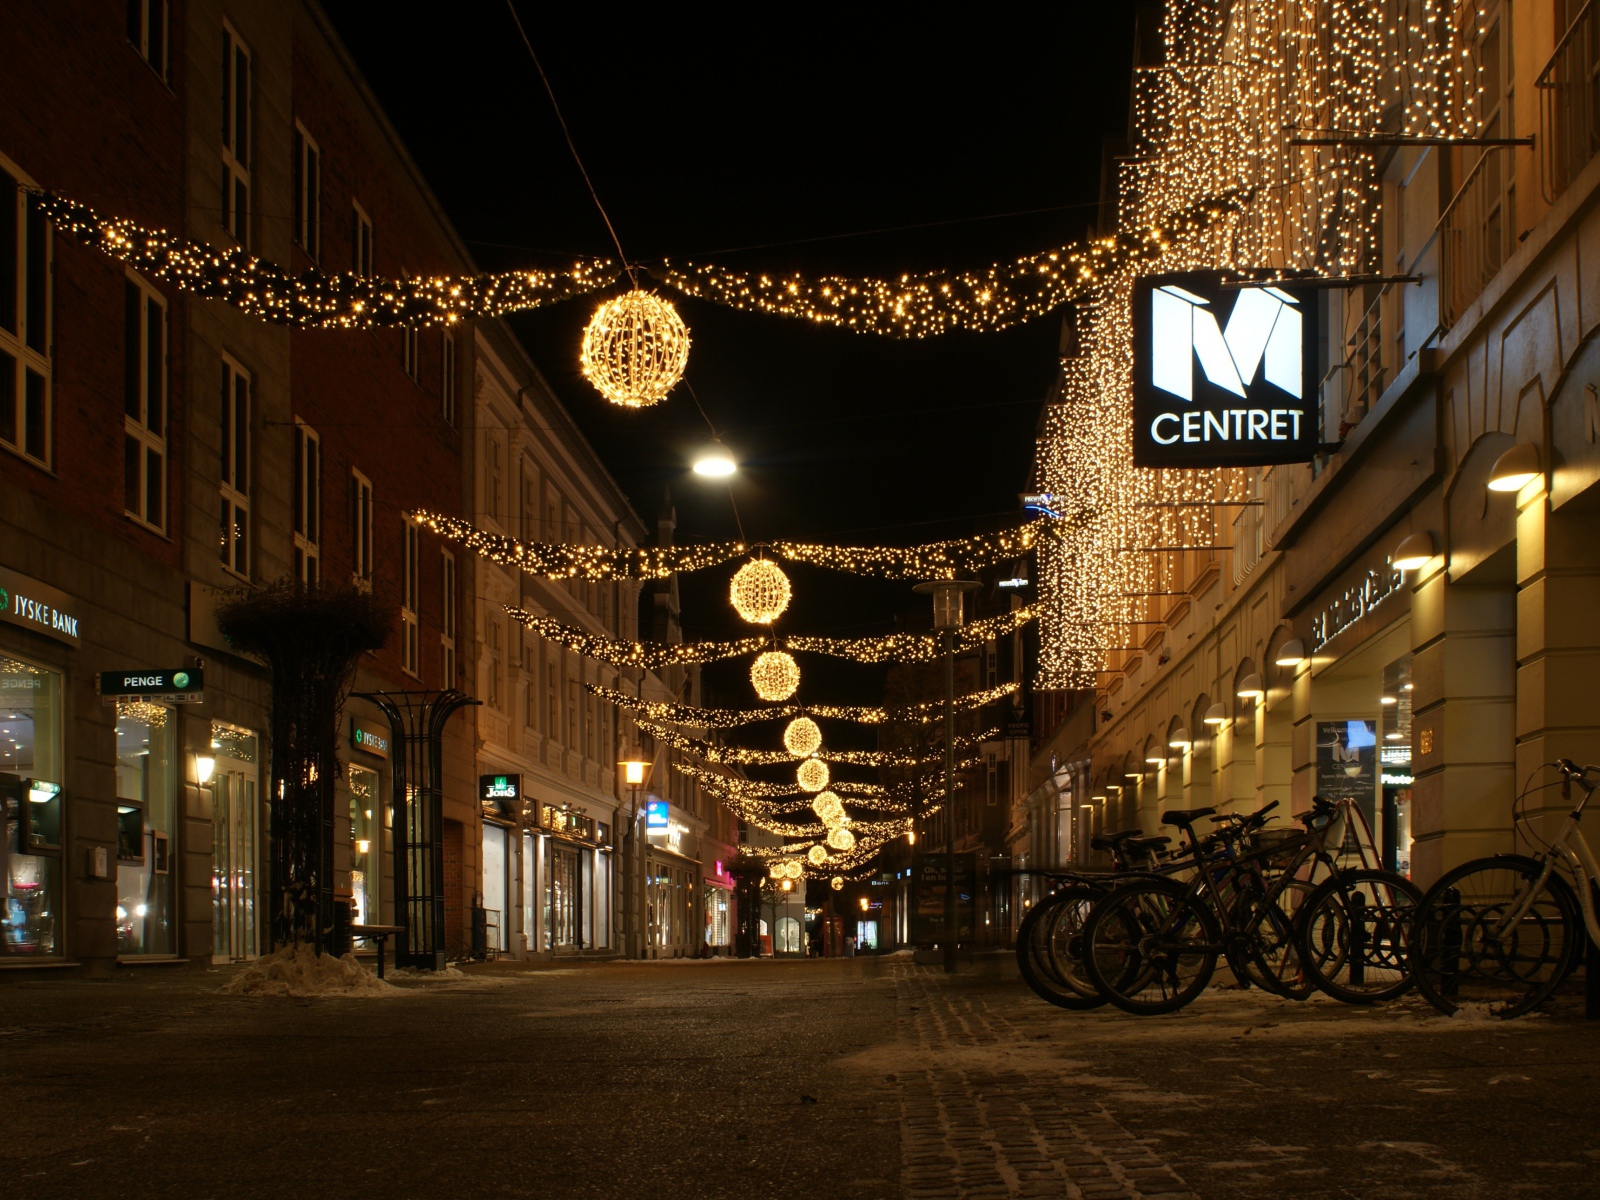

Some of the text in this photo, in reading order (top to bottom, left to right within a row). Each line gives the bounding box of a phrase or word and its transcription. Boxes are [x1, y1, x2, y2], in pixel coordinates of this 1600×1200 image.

[1152, 285, 1303, 402] M
[1150, 409, 1304, 445] CENTRET
[14, 594, 78, 638] JYSKE BANK
[123, 676, 163, 687] PENGE
